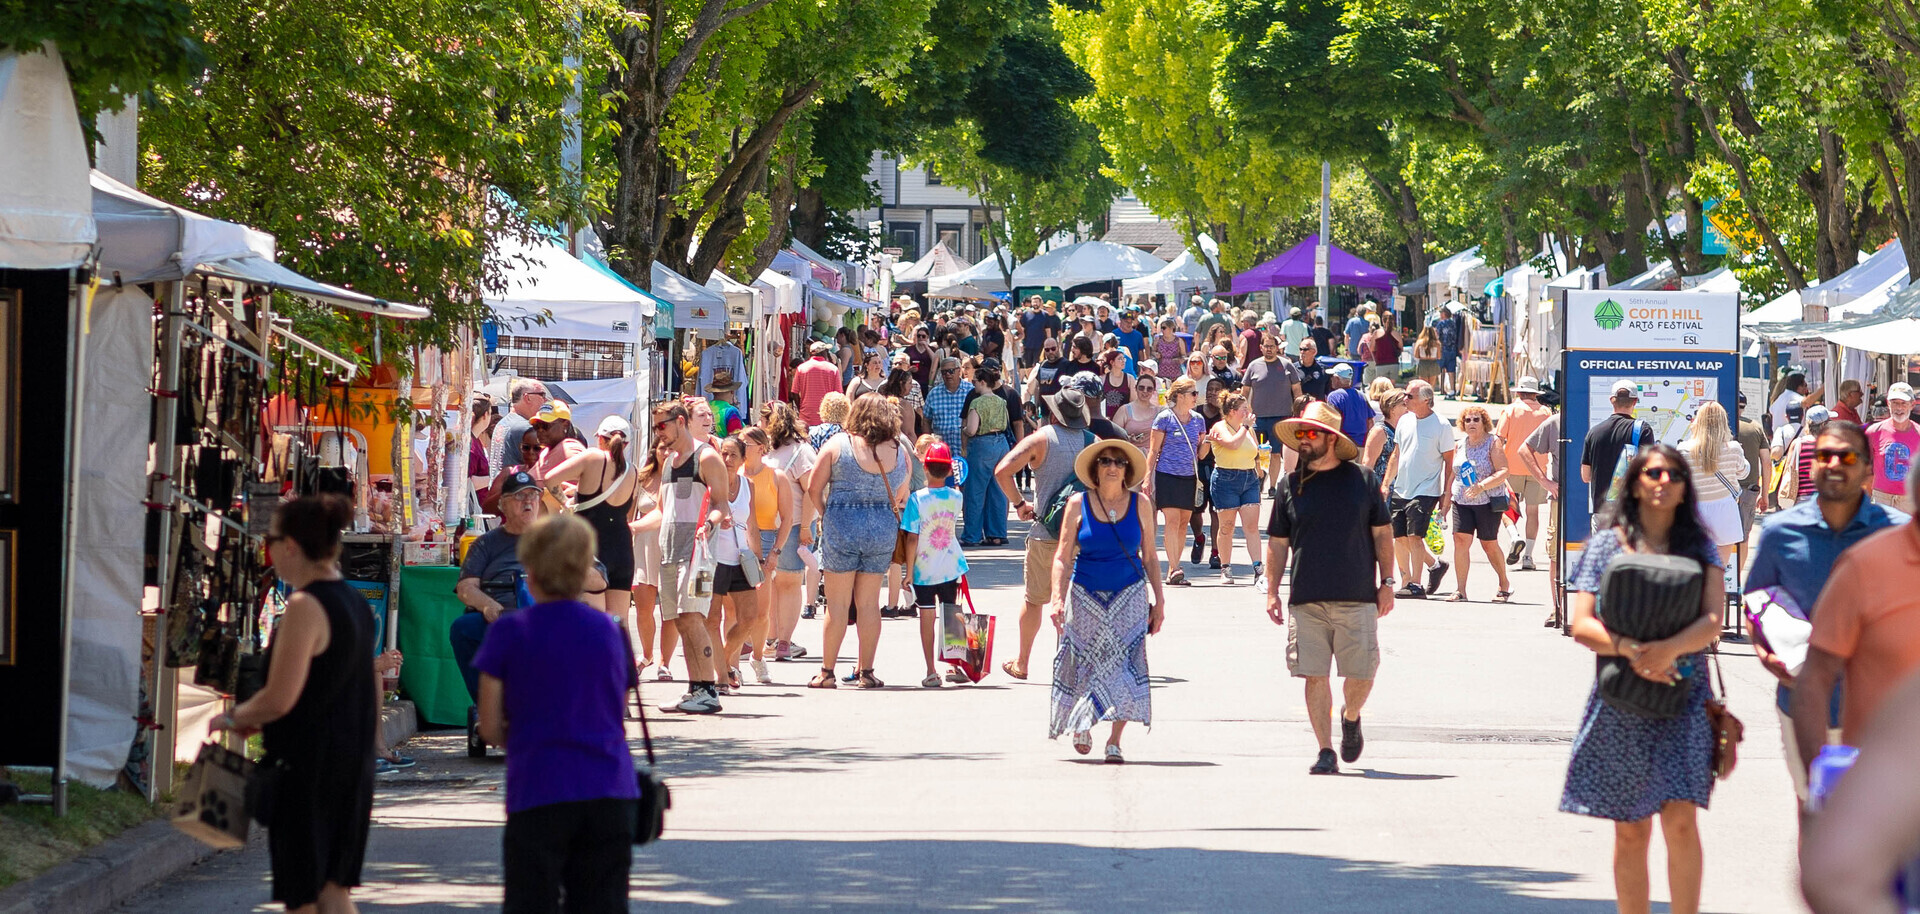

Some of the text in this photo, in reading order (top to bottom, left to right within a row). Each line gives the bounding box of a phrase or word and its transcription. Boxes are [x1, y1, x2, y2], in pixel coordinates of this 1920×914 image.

[1672, 309, 1703, 320] HILL
[1628, 321, 1703, 332] ARTS FESTIVAL
[1683, 335, 1699, 345] ESL
[1580, 360, 1724, 371] OFFICIAL FESTIVAL MAP
